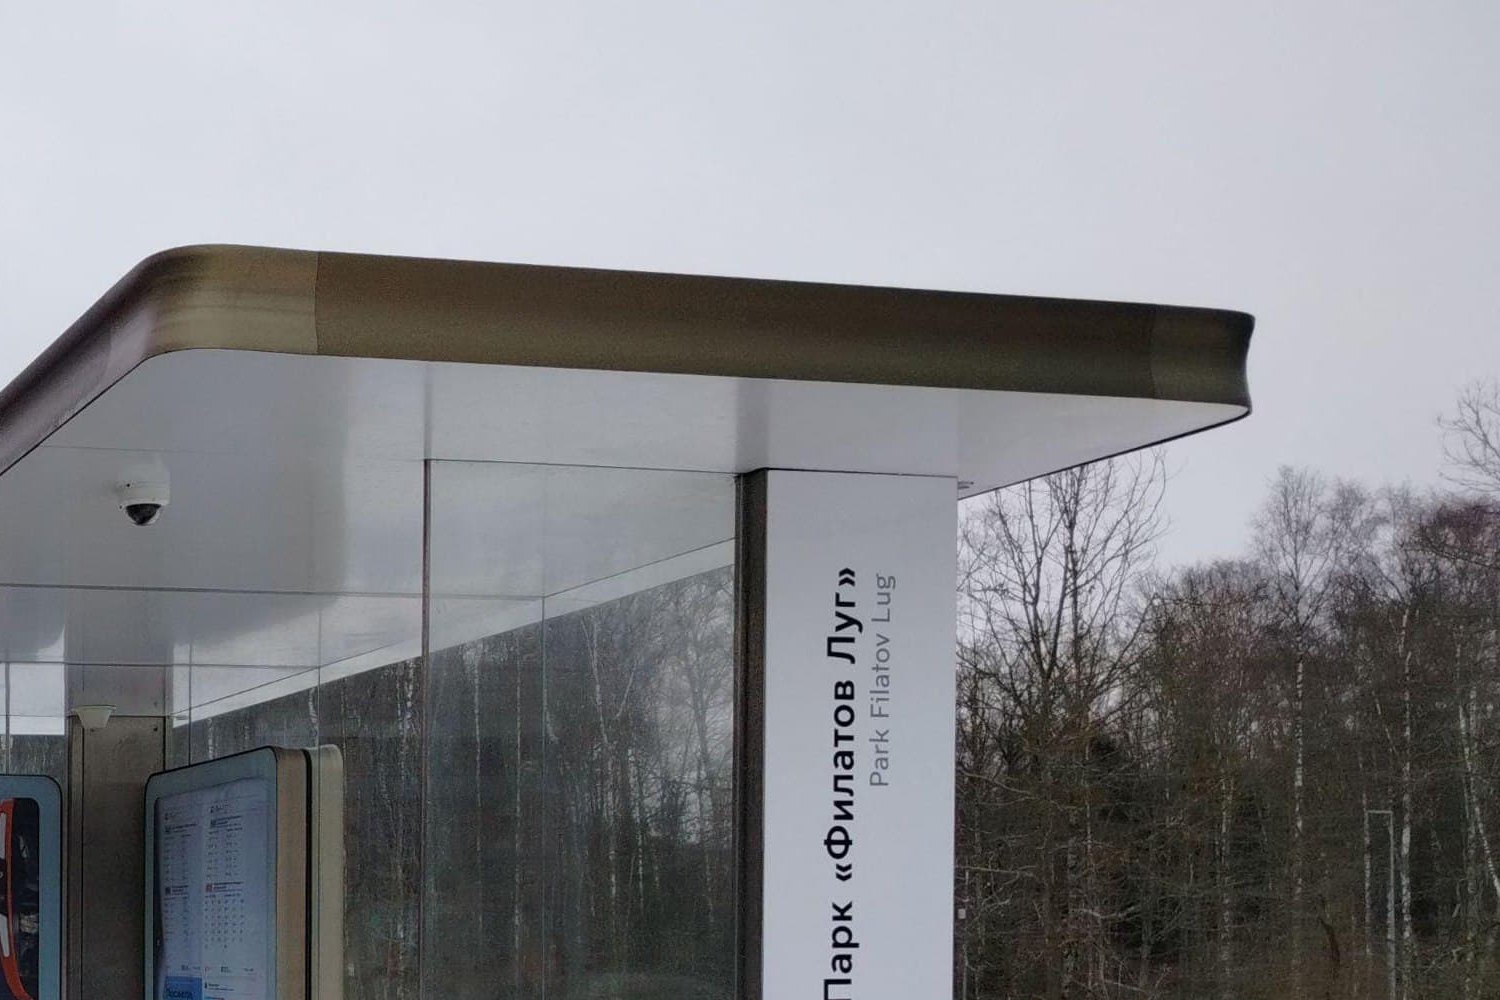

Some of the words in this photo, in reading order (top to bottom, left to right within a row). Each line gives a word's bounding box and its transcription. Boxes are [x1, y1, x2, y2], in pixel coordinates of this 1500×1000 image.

[826, 567, 864, 665] Луг»
[871, 574, 896, 623] Lug
[869, 632, 891, 718] Filatov
[823, 679, 856, 882] «Филатов
[869, 729, 890, 787] Park
